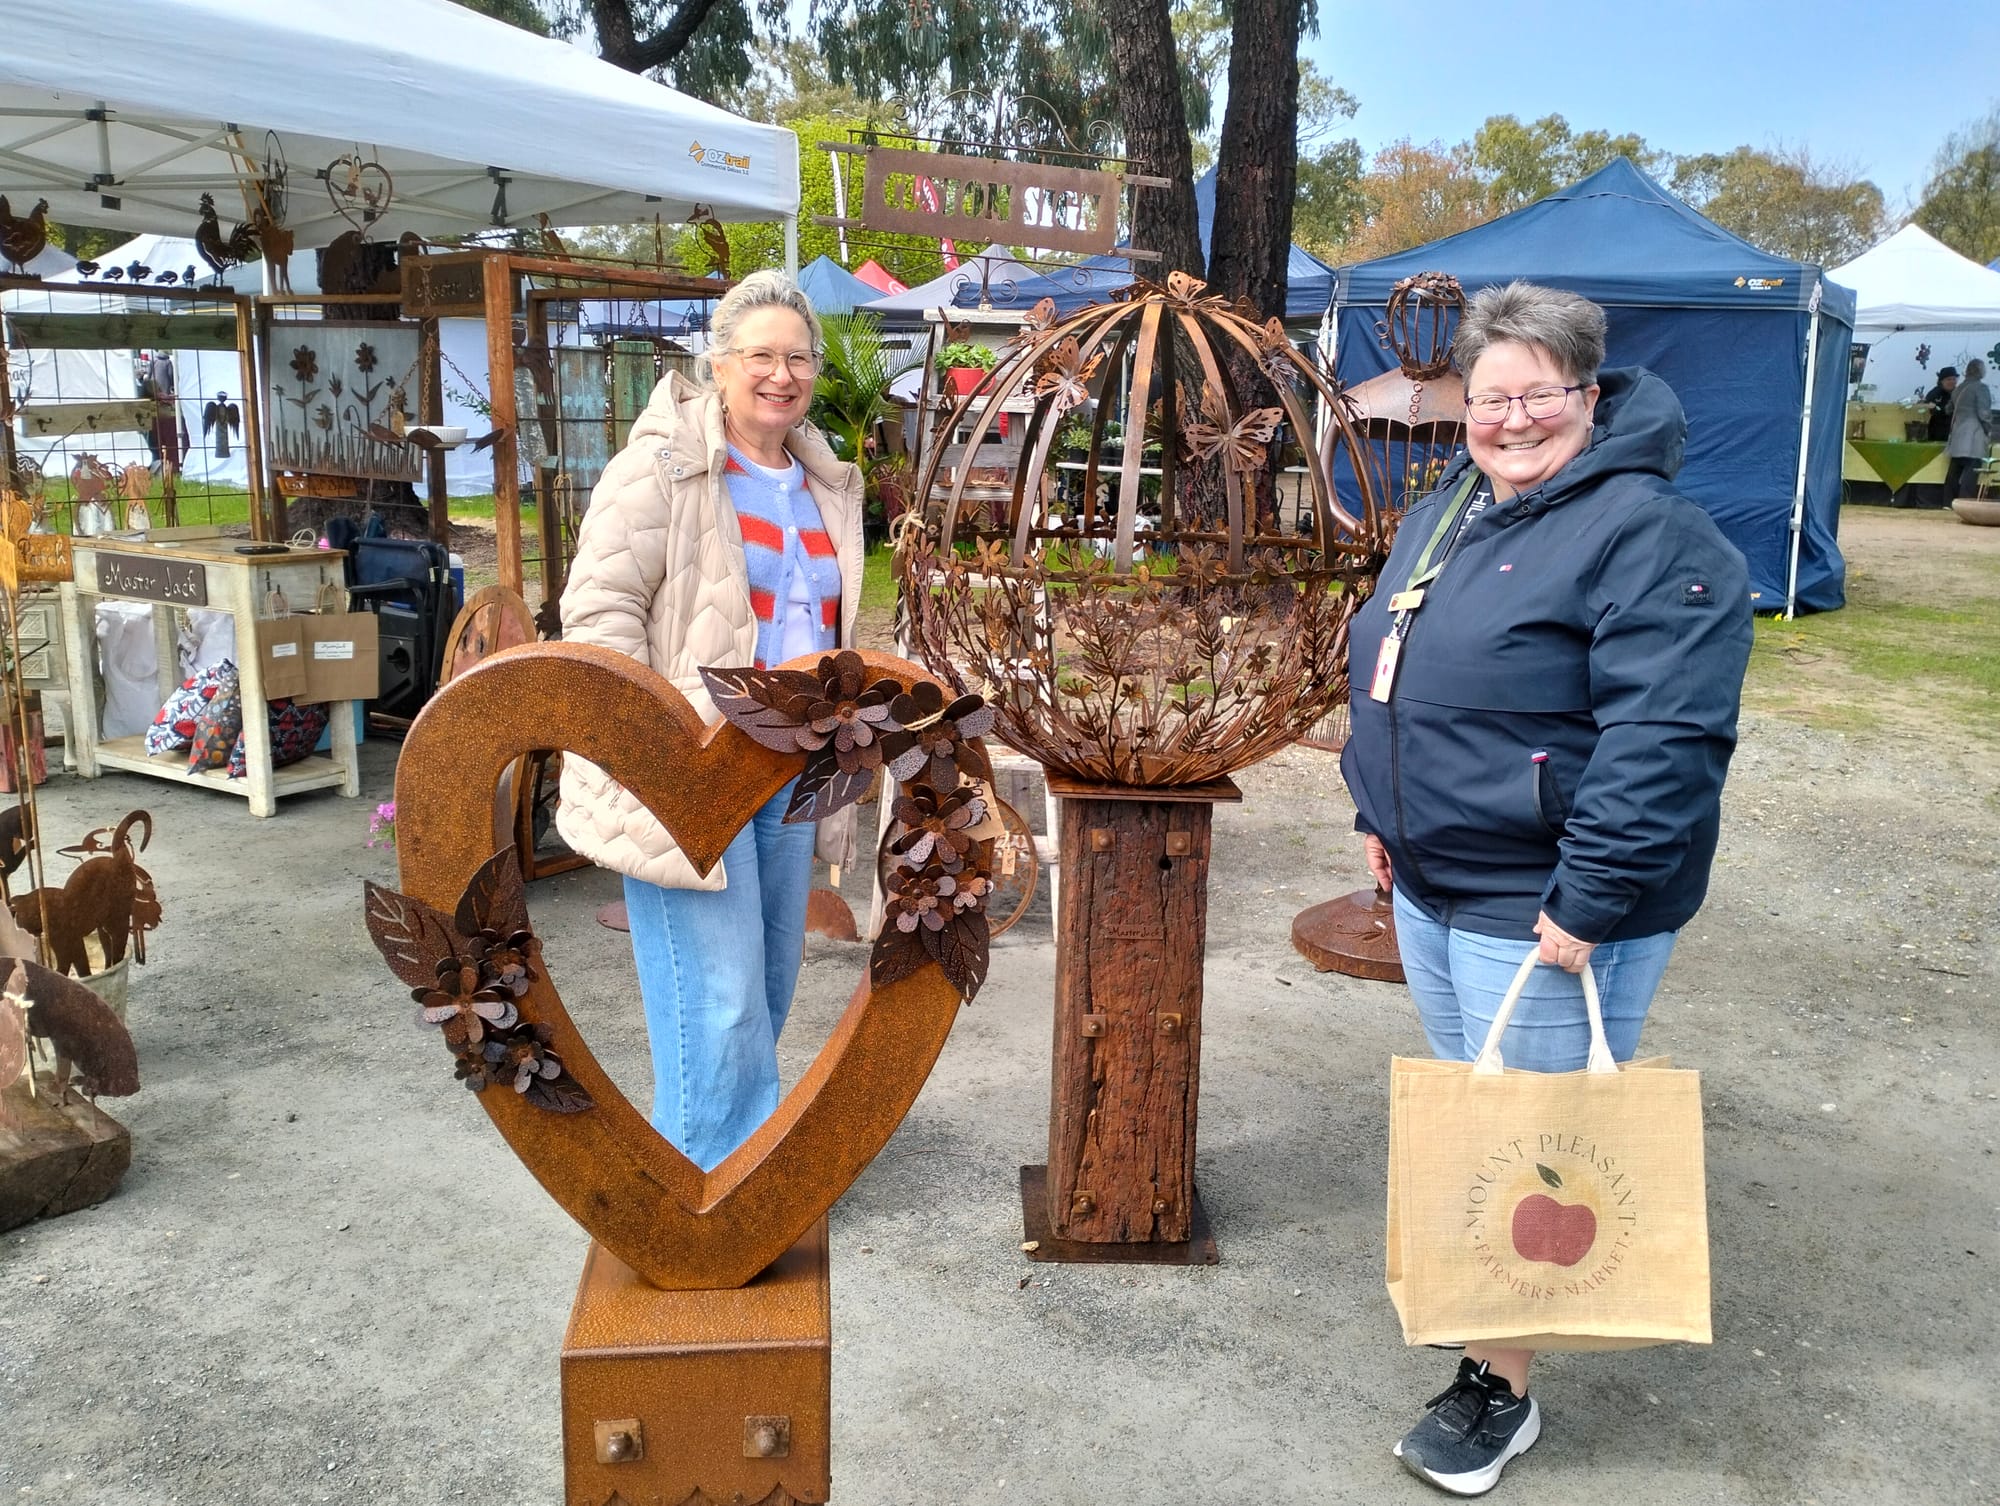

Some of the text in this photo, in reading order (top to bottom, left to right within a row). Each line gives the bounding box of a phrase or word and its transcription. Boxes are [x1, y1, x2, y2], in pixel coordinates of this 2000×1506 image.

[706, 148, 750, 169] OZtrail
[883, 171, 1013, 221] CUSTOM
[1023, 186, 1101, 232] SIGN
[104, 561, 197, 597] Master Jack
[1466, 1133, 1637, 1229] MOUNT PLEASANT
[1475, 1237, 1631, 1300] FARMERS MARKET
